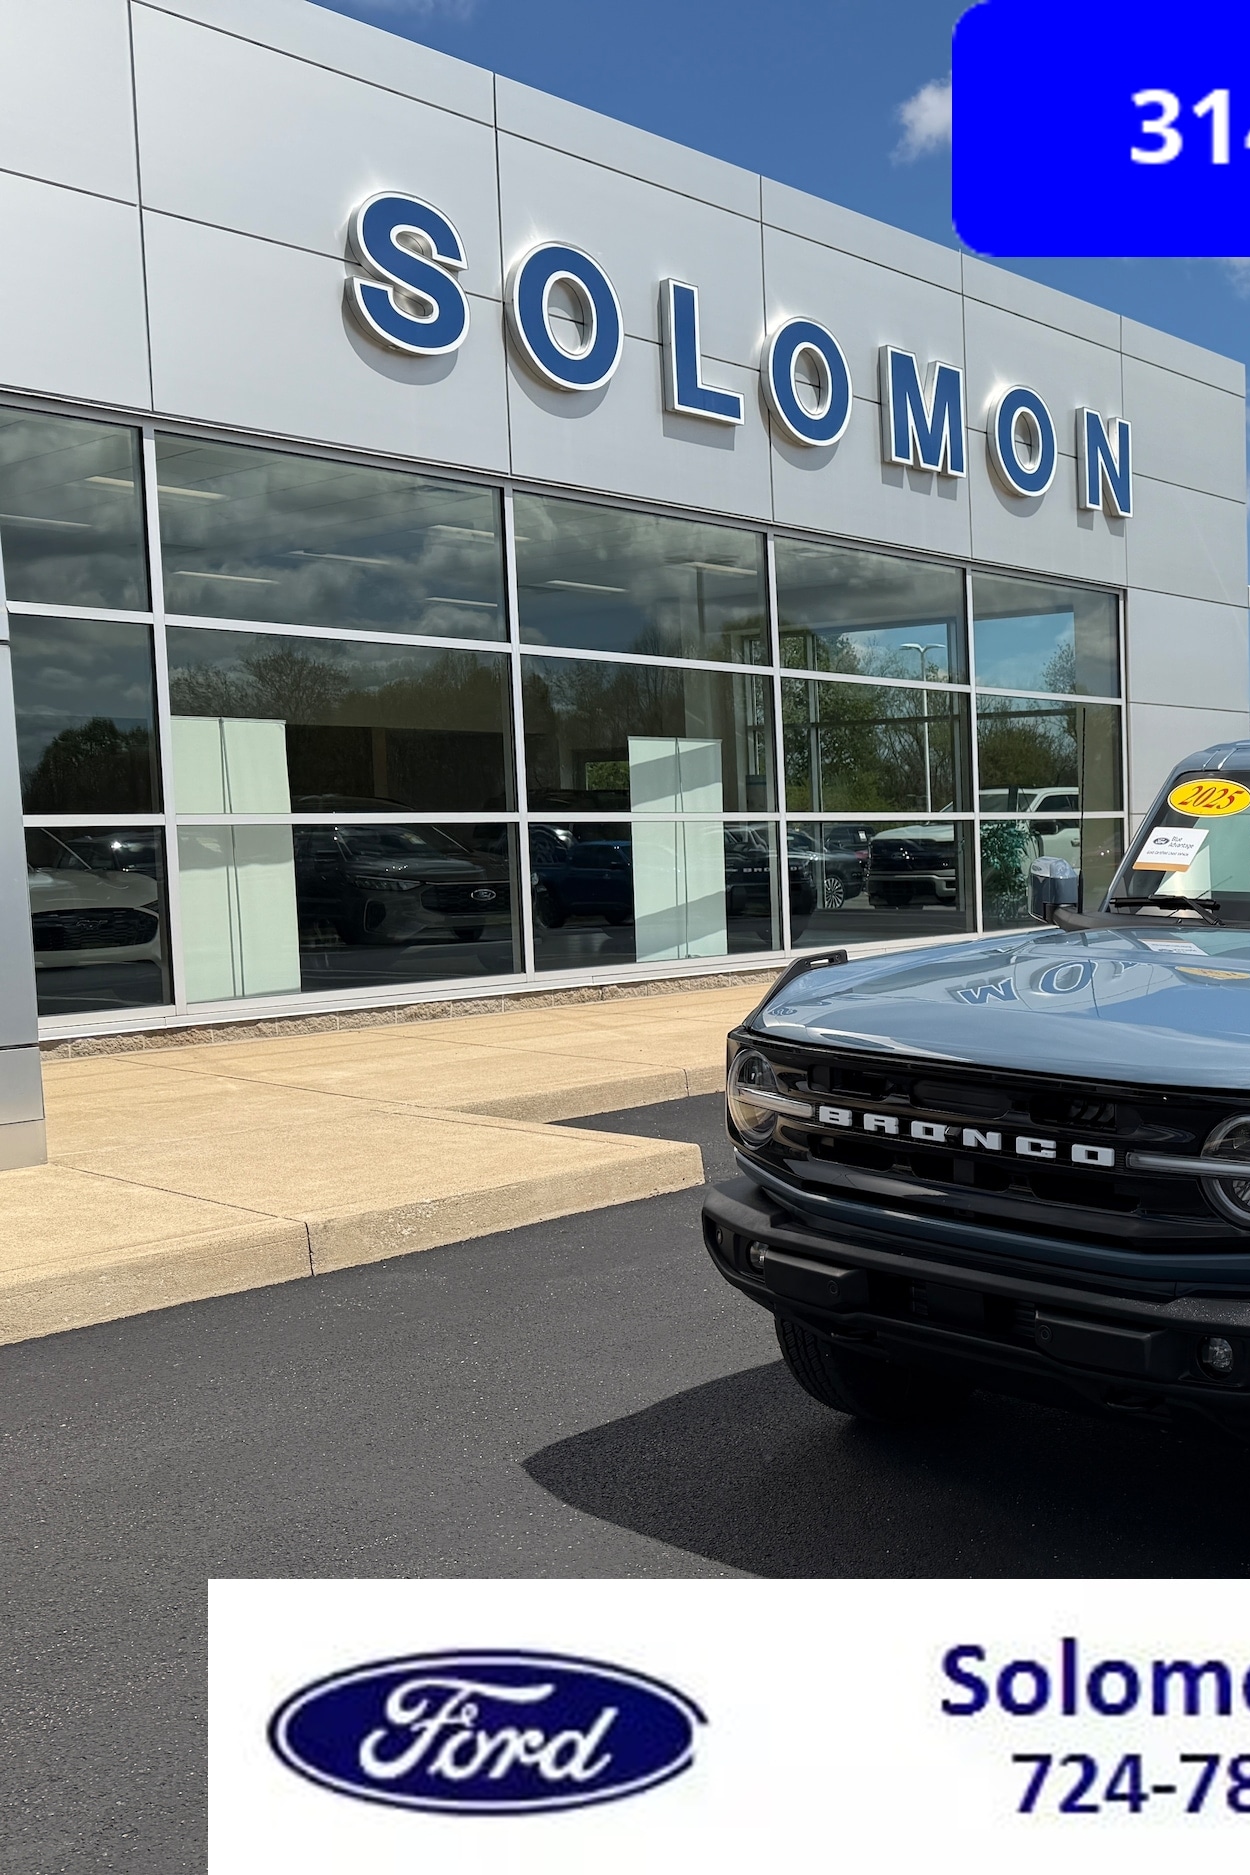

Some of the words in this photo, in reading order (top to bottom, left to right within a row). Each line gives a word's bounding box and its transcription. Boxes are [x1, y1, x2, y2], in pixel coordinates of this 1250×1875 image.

[345, 190, 1134, 519] SOLOMON
[1178, 785, 1245, 810] 2025
[819, 1105, 1115, 1167] BRONCO
